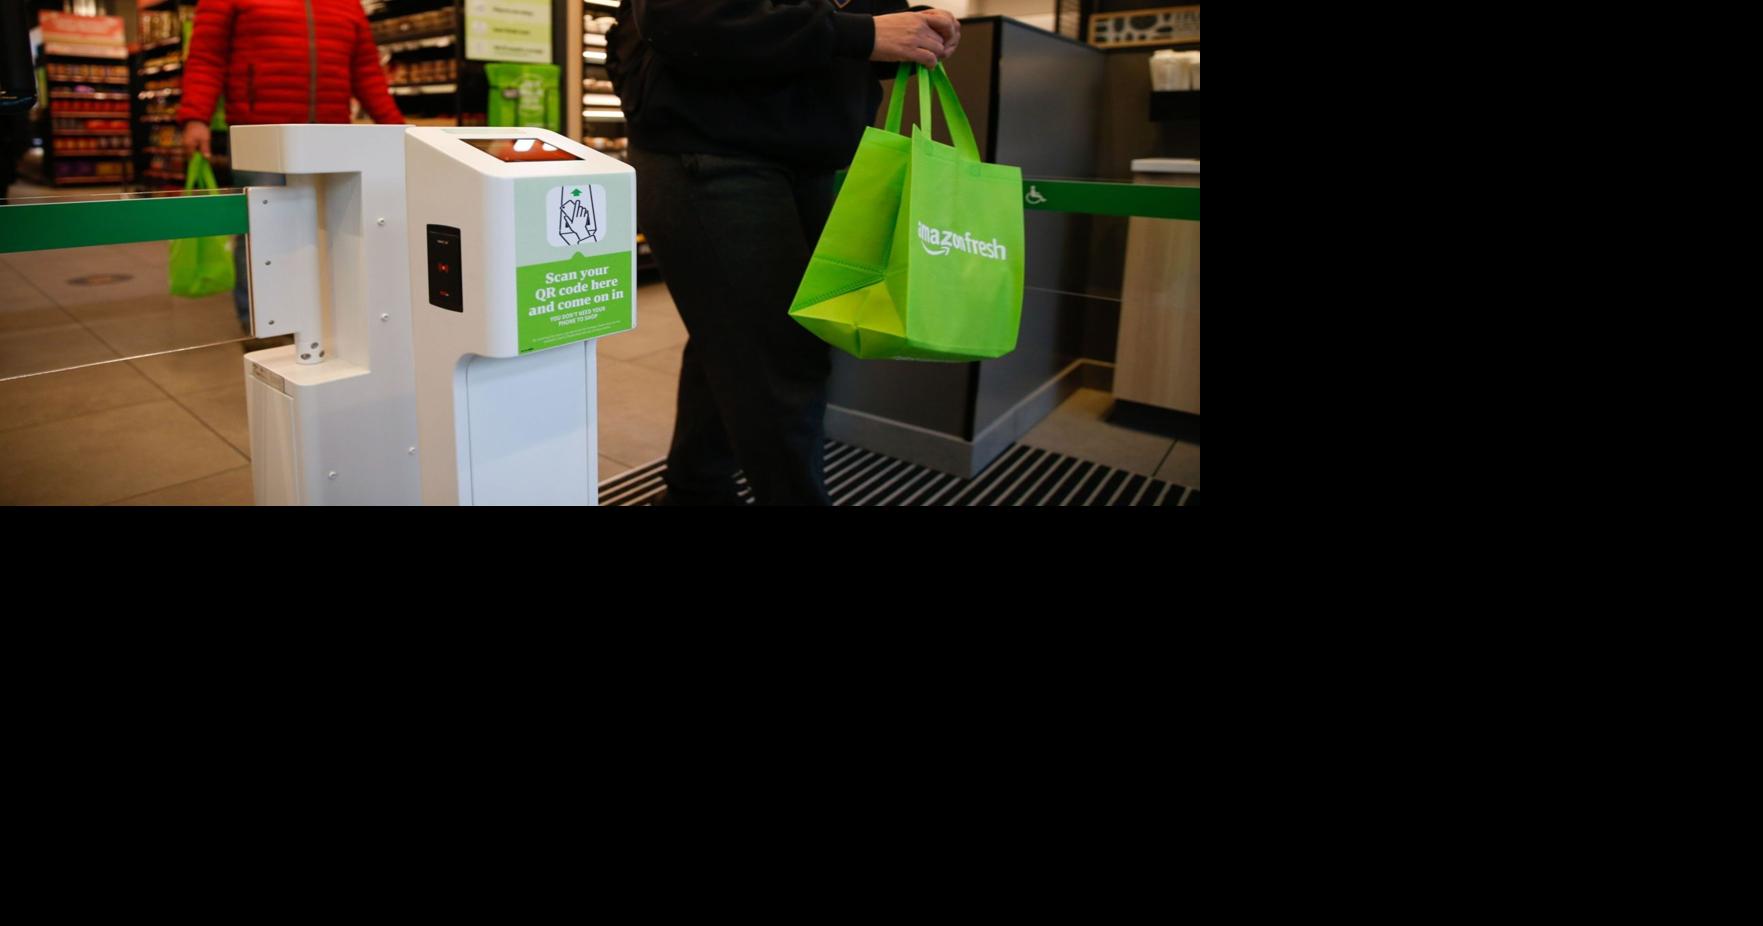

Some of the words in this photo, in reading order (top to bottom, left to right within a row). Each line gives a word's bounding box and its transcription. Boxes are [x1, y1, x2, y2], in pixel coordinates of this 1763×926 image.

[545, 271, 577, 284] Scan
[580, 266, 609, 281] your
[535, 287, 556, 301] QR
[559, 283, 589, 296] code
[591, 278, 618, 290] here
[528, 301, 554, 316] and
[557, 296, 591, 310] come
[594, 294, 609, 304] on
[611, 289, 624, 299] in
